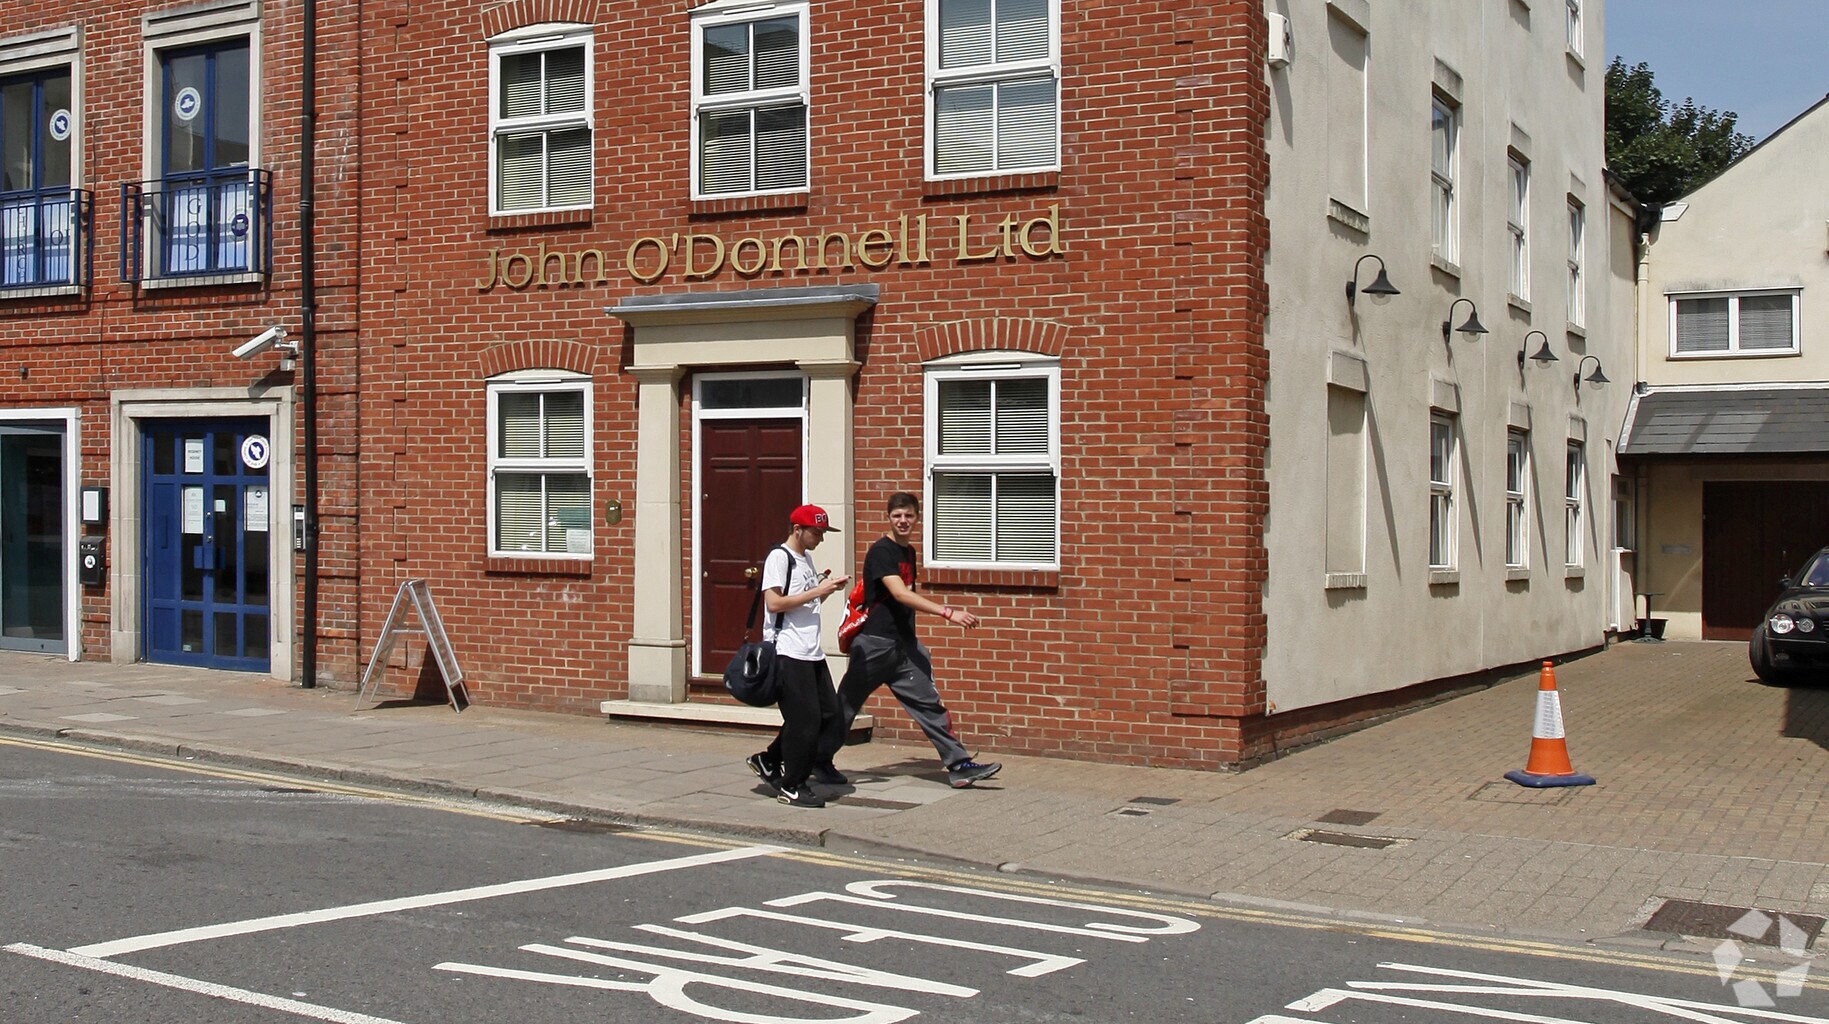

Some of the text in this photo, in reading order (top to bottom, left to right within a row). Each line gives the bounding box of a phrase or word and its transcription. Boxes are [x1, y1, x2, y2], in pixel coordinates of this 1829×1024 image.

[476, 203, 1063, 290] John O'Donnell Ltd
[432, 880, 1201, 1024] CLEAR
